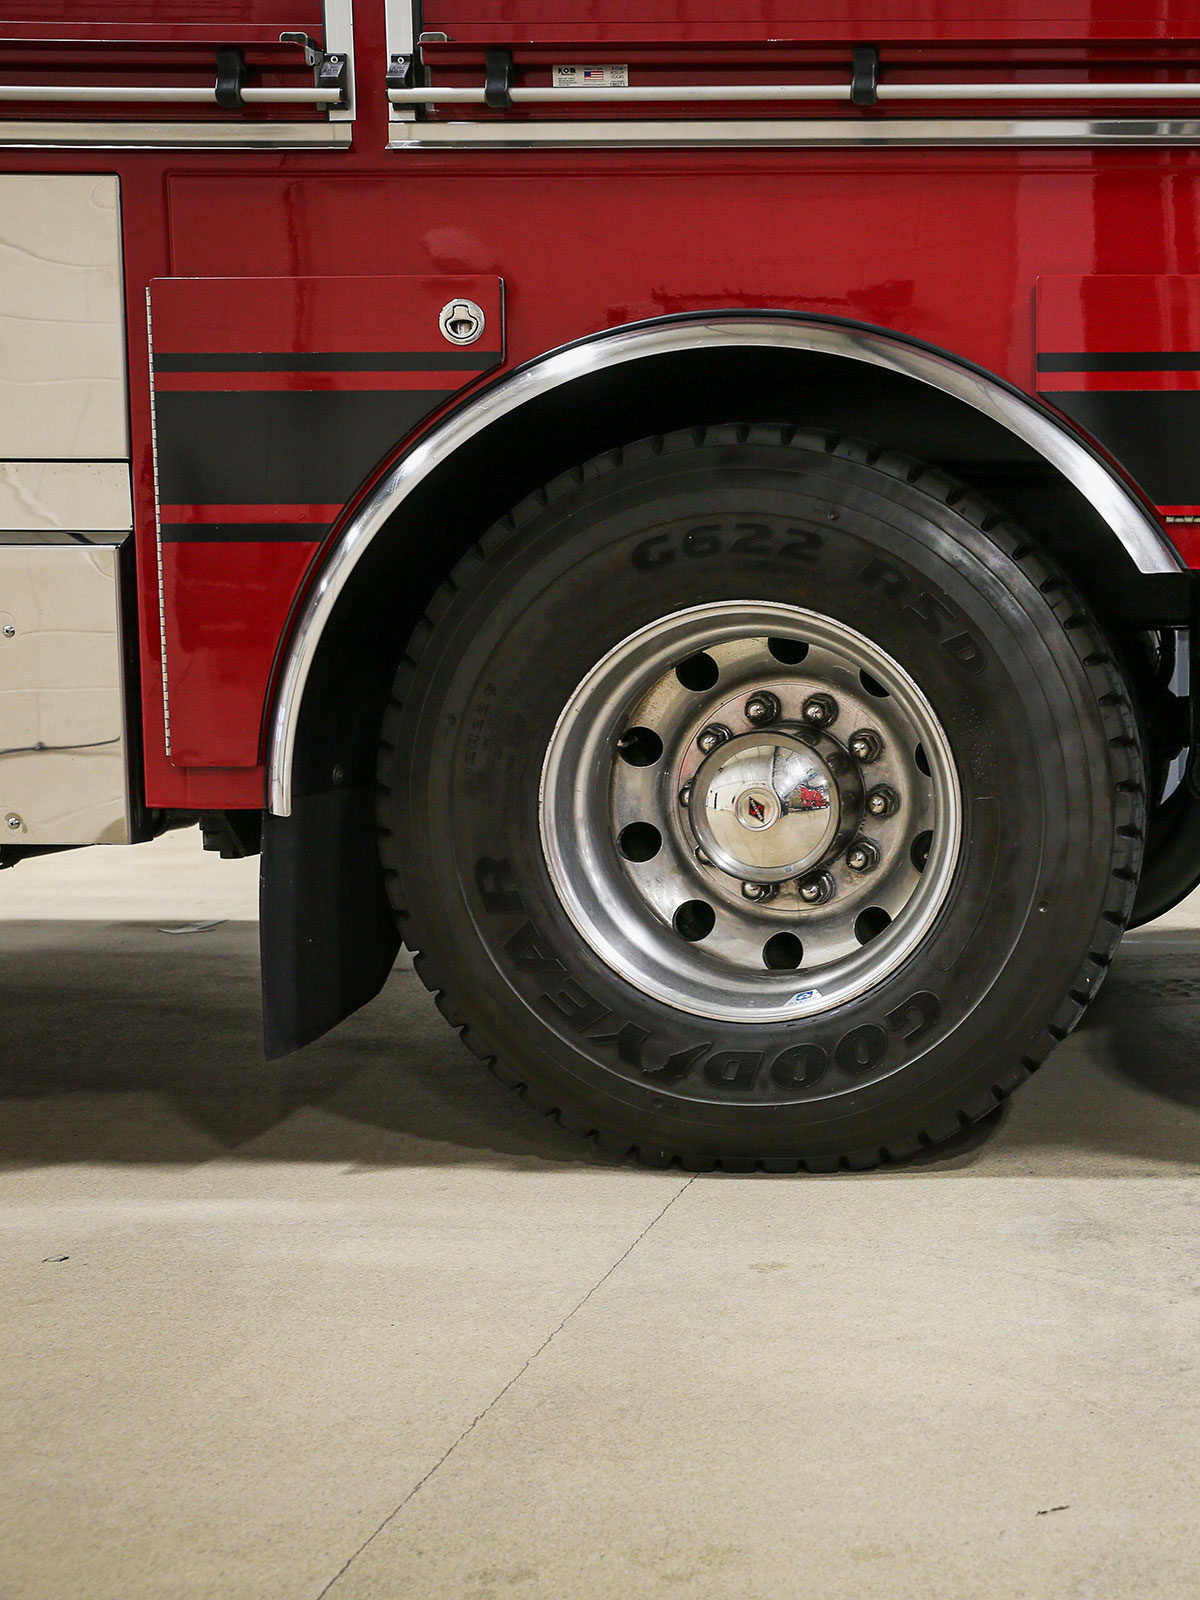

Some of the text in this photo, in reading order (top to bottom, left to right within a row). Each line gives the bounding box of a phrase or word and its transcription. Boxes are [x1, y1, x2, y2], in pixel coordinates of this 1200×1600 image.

[630, 522, 989, 676] G622 RSD
[474, 855, 941, 1091] GOODYEAR
